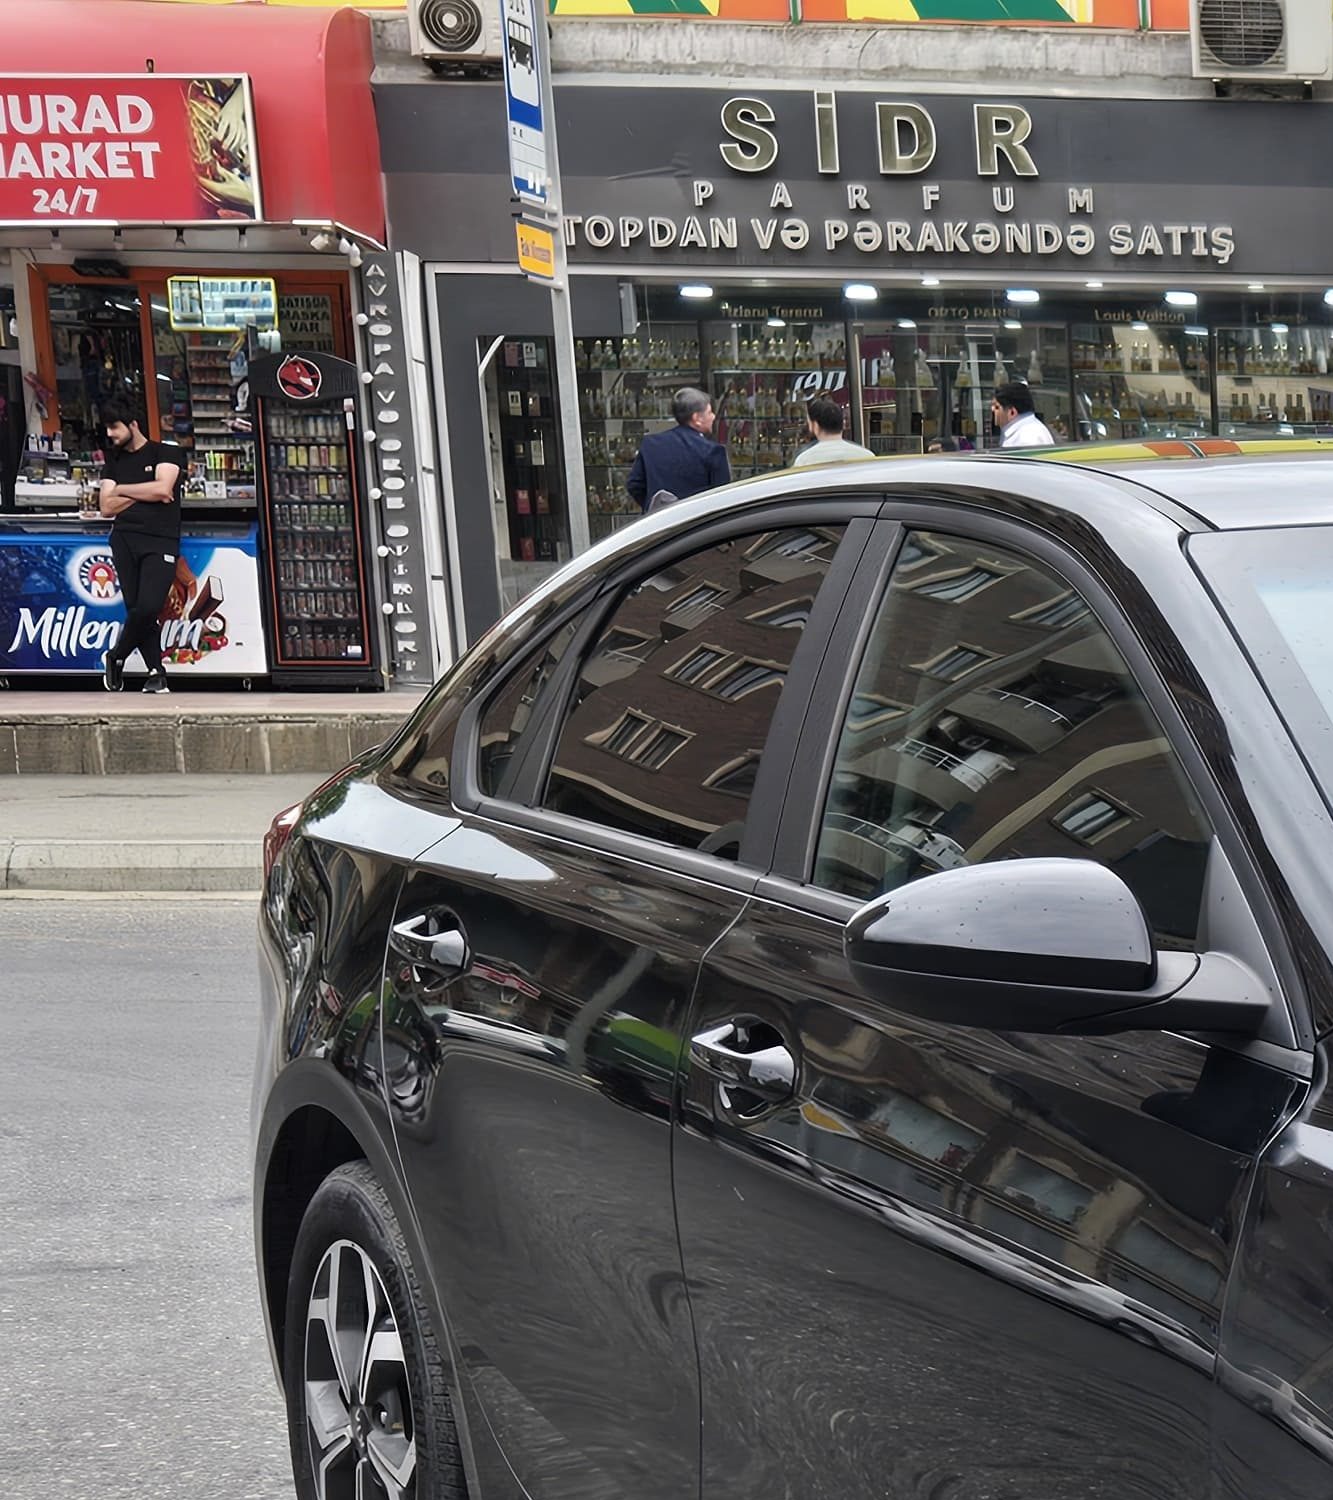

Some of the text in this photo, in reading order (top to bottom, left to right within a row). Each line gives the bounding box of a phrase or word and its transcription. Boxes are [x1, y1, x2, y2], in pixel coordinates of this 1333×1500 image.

[0, 95, 153, 134] URAD
[719, 90, 1039, 176] SİDR
[0, 142, 161, 178] ARKET
[32, 185, 97, 215] 24/7
[693, 181, 1094, 214] PARFUM
[564, 216, 1236, 265] TOPDAN VƏ PƏRAKƏNDƏ SATIŞ
[1095, 309, 1133, 321] Louis
[8, 606, 203, 659] Millenm
